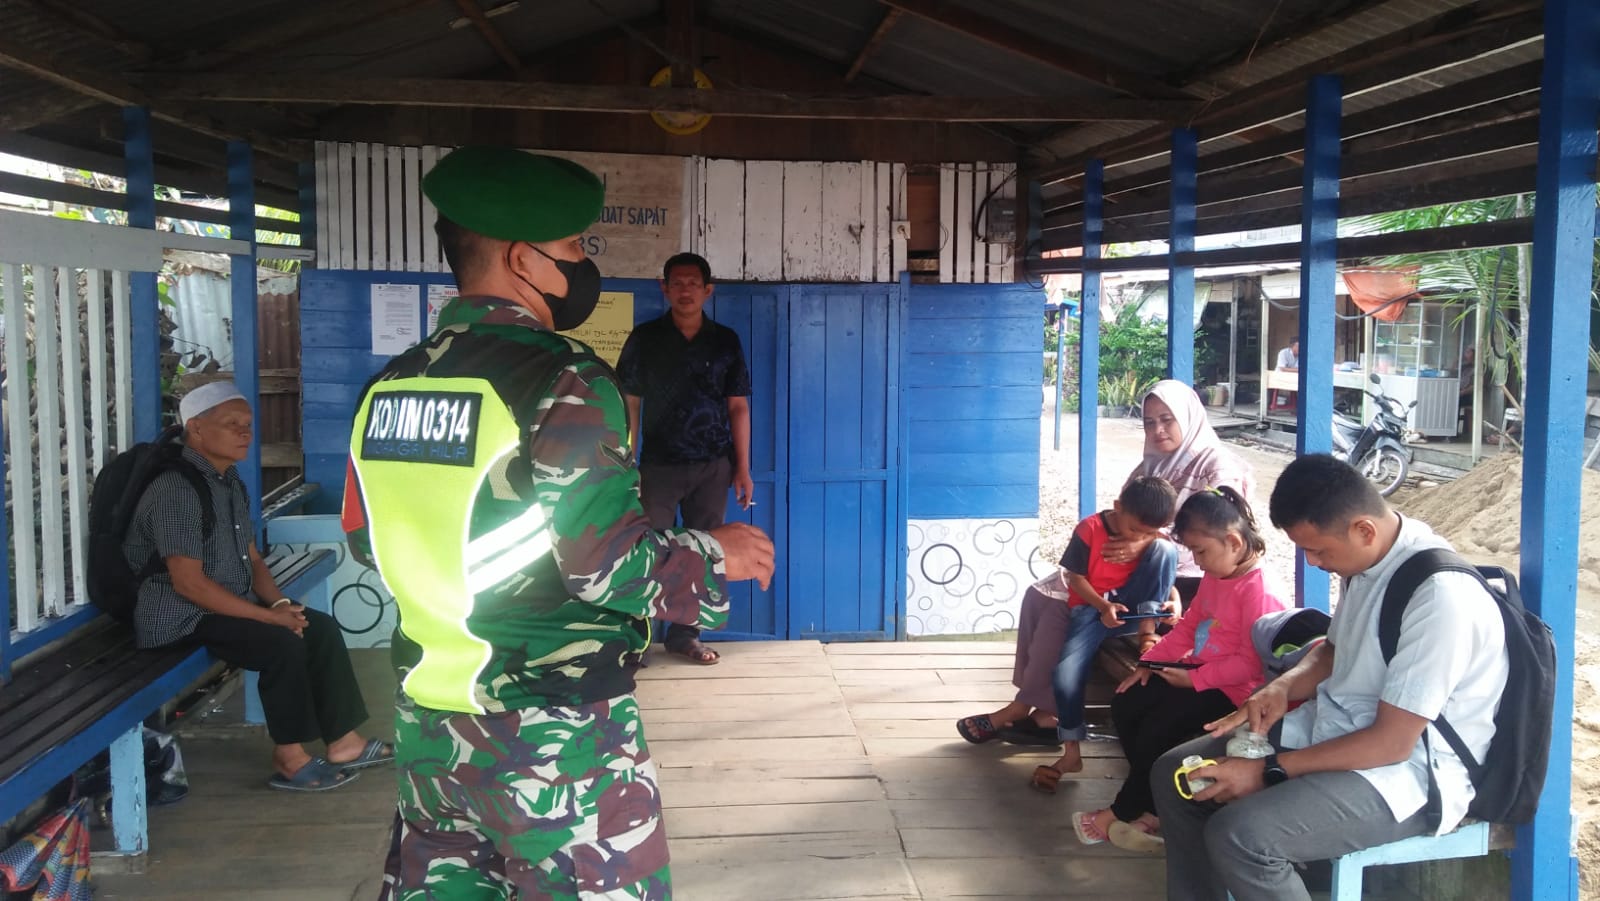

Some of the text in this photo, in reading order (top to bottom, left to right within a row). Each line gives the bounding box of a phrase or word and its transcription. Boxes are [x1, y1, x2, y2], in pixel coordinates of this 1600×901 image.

[597, 206, 668, 226] OAT SAPAT
[422, 397, 472, 443] 0314
